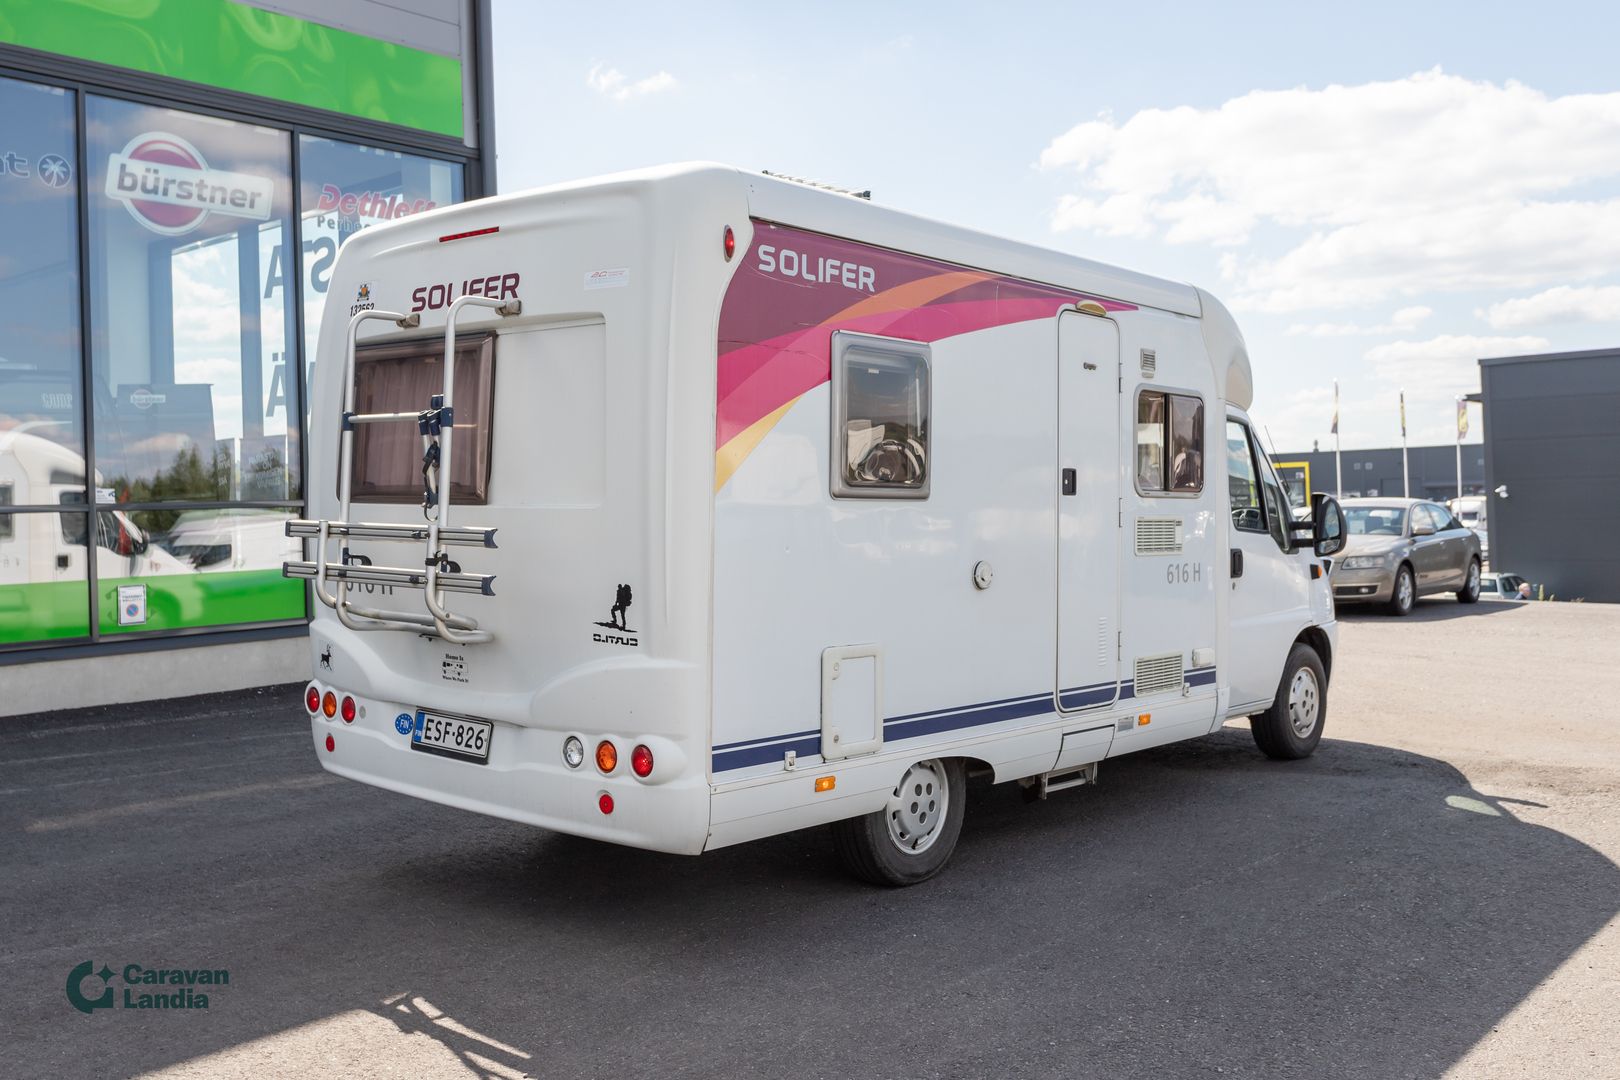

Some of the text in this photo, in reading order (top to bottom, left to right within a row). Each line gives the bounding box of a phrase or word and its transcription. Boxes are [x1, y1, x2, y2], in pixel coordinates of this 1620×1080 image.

[117, 163, 261, 209] bürstner
[758, 244, 875, 292] SOLIFER
[1167, 562, 1201, 584] 616 H
[400, 719, 409, 728] FIN
[424, 718, 486, 750] ESF-826
